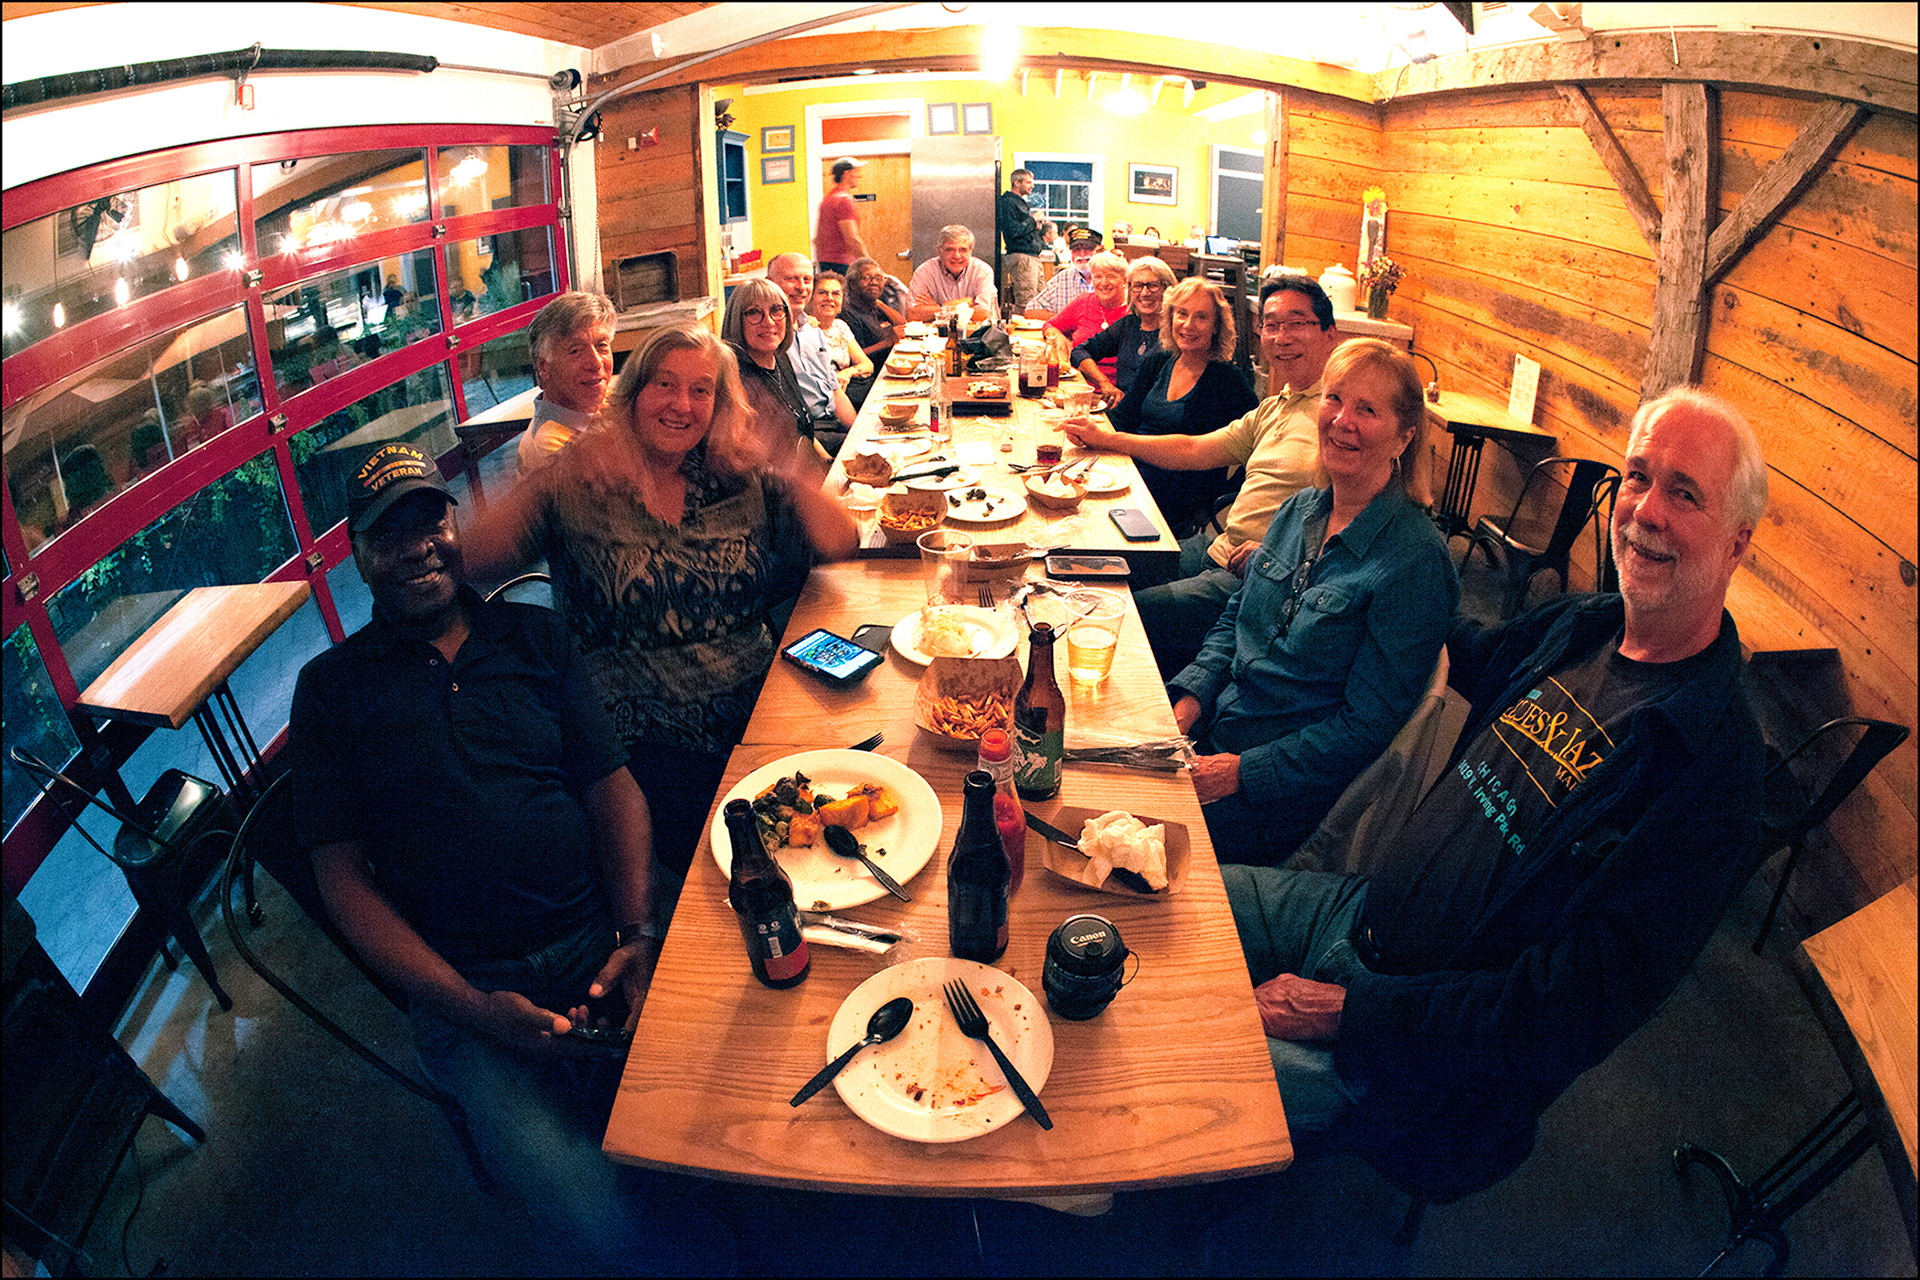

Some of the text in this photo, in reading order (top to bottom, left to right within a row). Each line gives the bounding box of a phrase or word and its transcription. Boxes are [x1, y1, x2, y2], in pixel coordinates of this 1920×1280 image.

[357, 445, 424, 479] VIETNAM
[371, 466, 422, 491] VETERAN
[1558, 727, 1604, 780] JAZ
[1473, 785, 1498, 818] Irving
[1507, 833, 1526, 856] Rd
[1069, 930, 1107, 945] Canon
